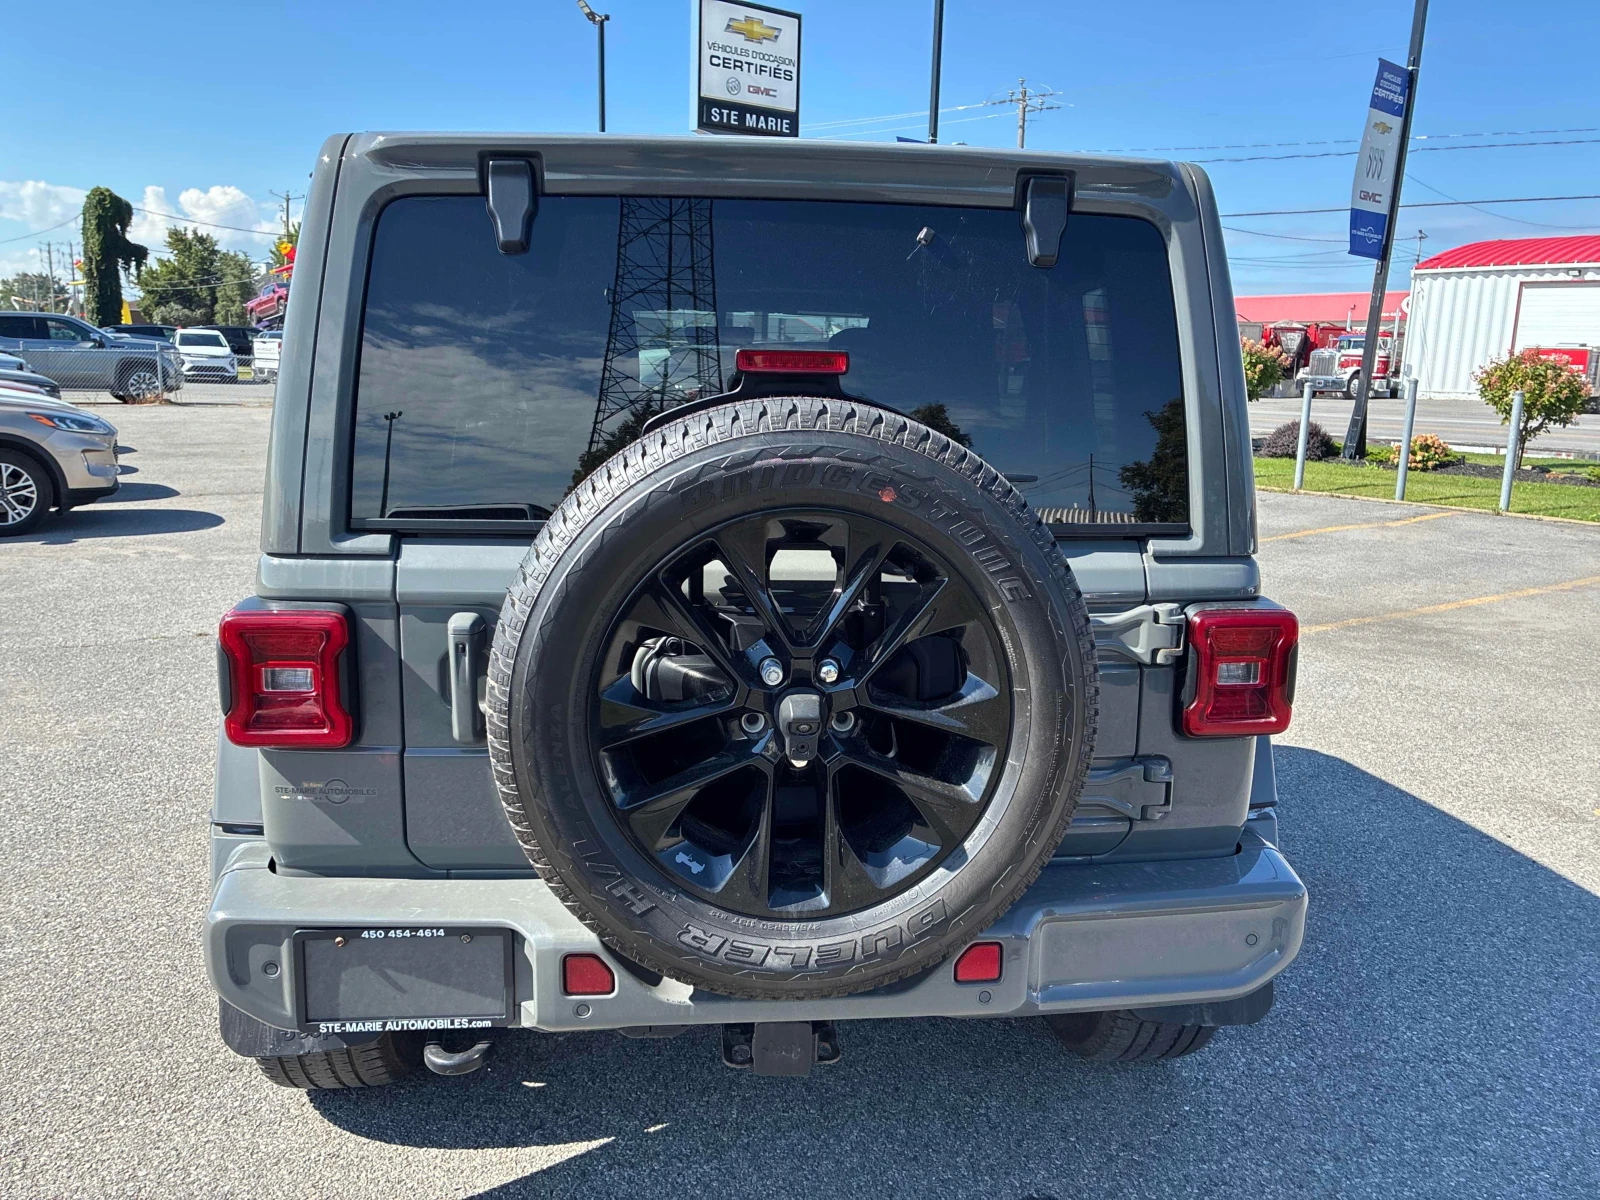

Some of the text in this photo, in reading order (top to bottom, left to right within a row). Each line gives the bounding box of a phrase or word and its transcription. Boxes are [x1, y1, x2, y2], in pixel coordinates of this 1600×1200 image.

[707, 41, 796, 67] VÉHICULES D'OCCASION
[709, 54, 793, 81] CERTIFIÉS
[747, 85, 777, 98] GMC
[711, 107, 790, 133] STE MARIE
[1359, 190, 1382, 204] GMC
[679, 463, 1032, 602] BRIDGESTONE
[275, 786, 377, 796] STE-MARIE AUTOMOBILES
[361, 928, 445, 939] 450 454-4614
[676, 897, 948, 969] DUELER
[319, 1018, 492, 1033] STE-MARIE AUTOMOBILES.com
